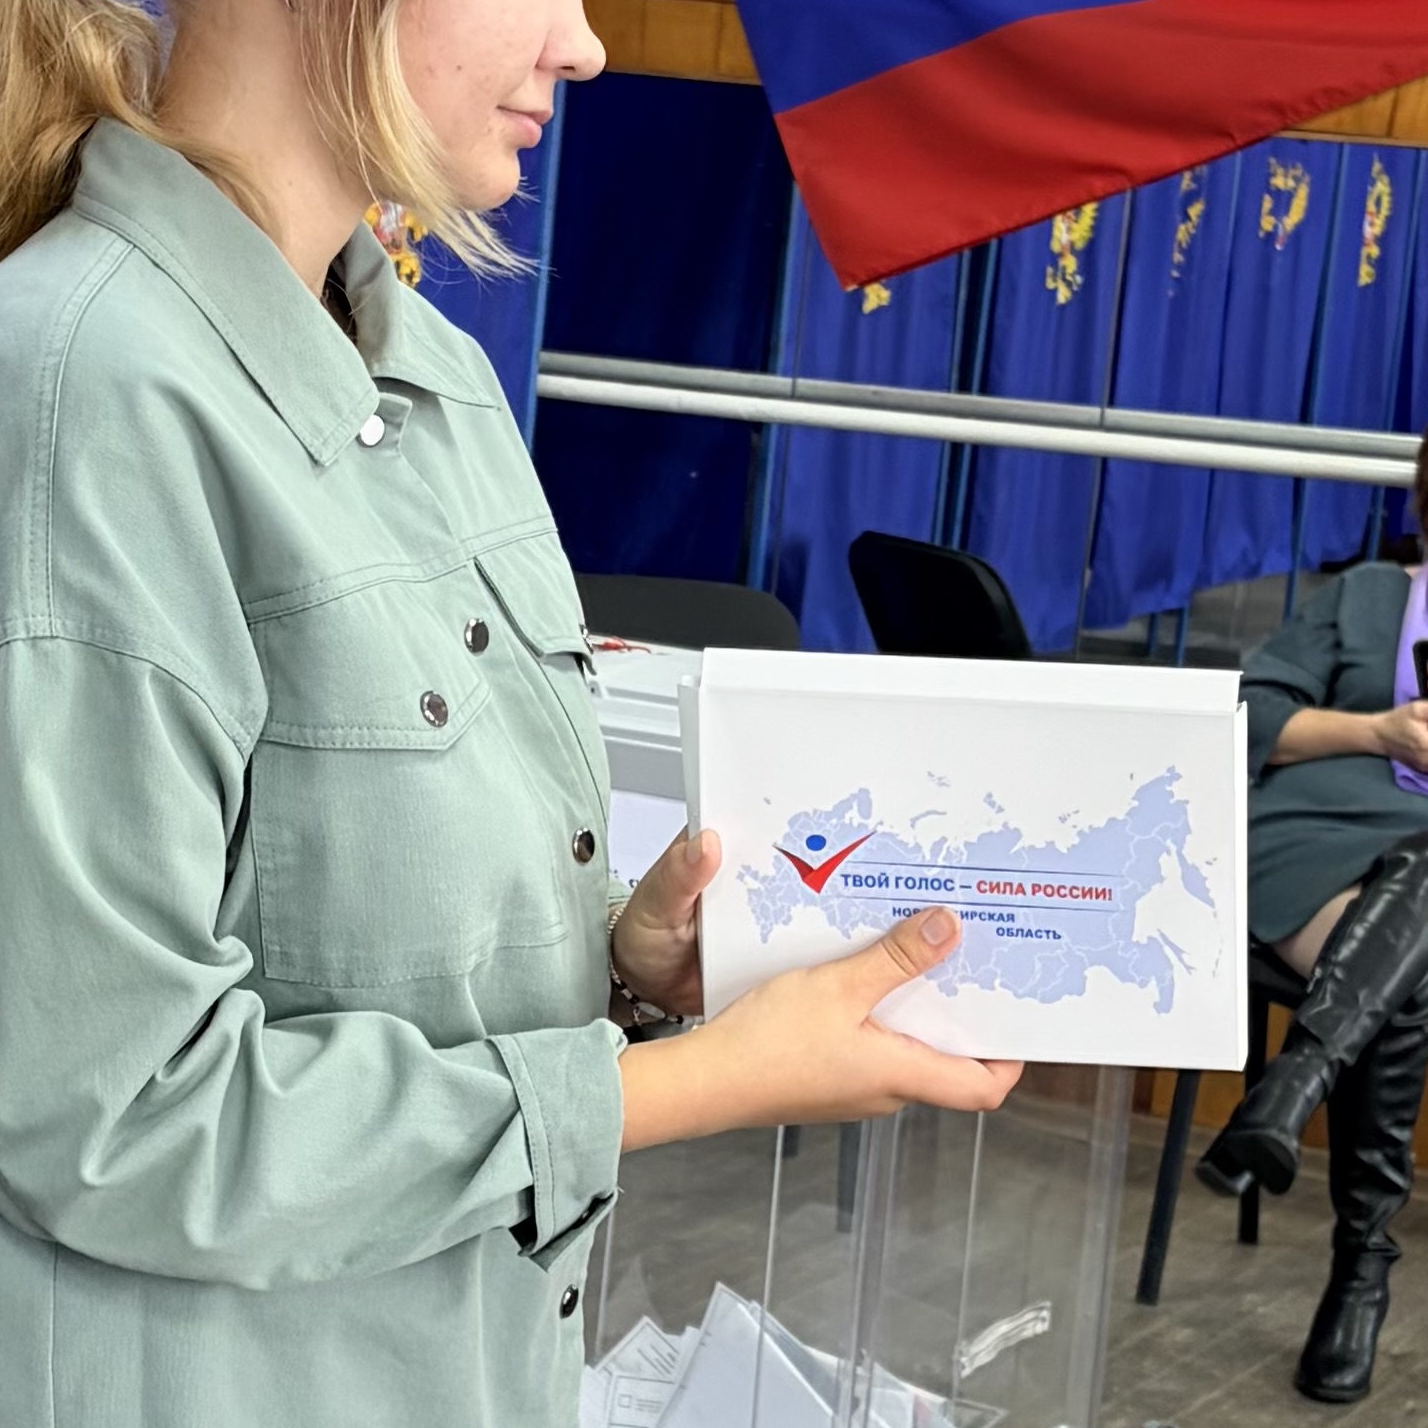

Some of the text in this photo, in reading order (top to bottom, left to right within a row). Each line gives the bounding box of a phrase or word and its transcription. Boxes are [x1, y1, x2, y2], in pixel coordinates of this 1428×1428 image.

[840, 872, 890, 890] ТВОЙ
[894, 875, 956, 892] ГОЛОС
[975, 879, 1028, 897] СИЛА
[1030, 883, 1113, 901] РОССИИ!
[891, 906, 1015, 923] НОВИРСКАЯ
[995, 926, 1062, 941] ОБЛАСТЬ
